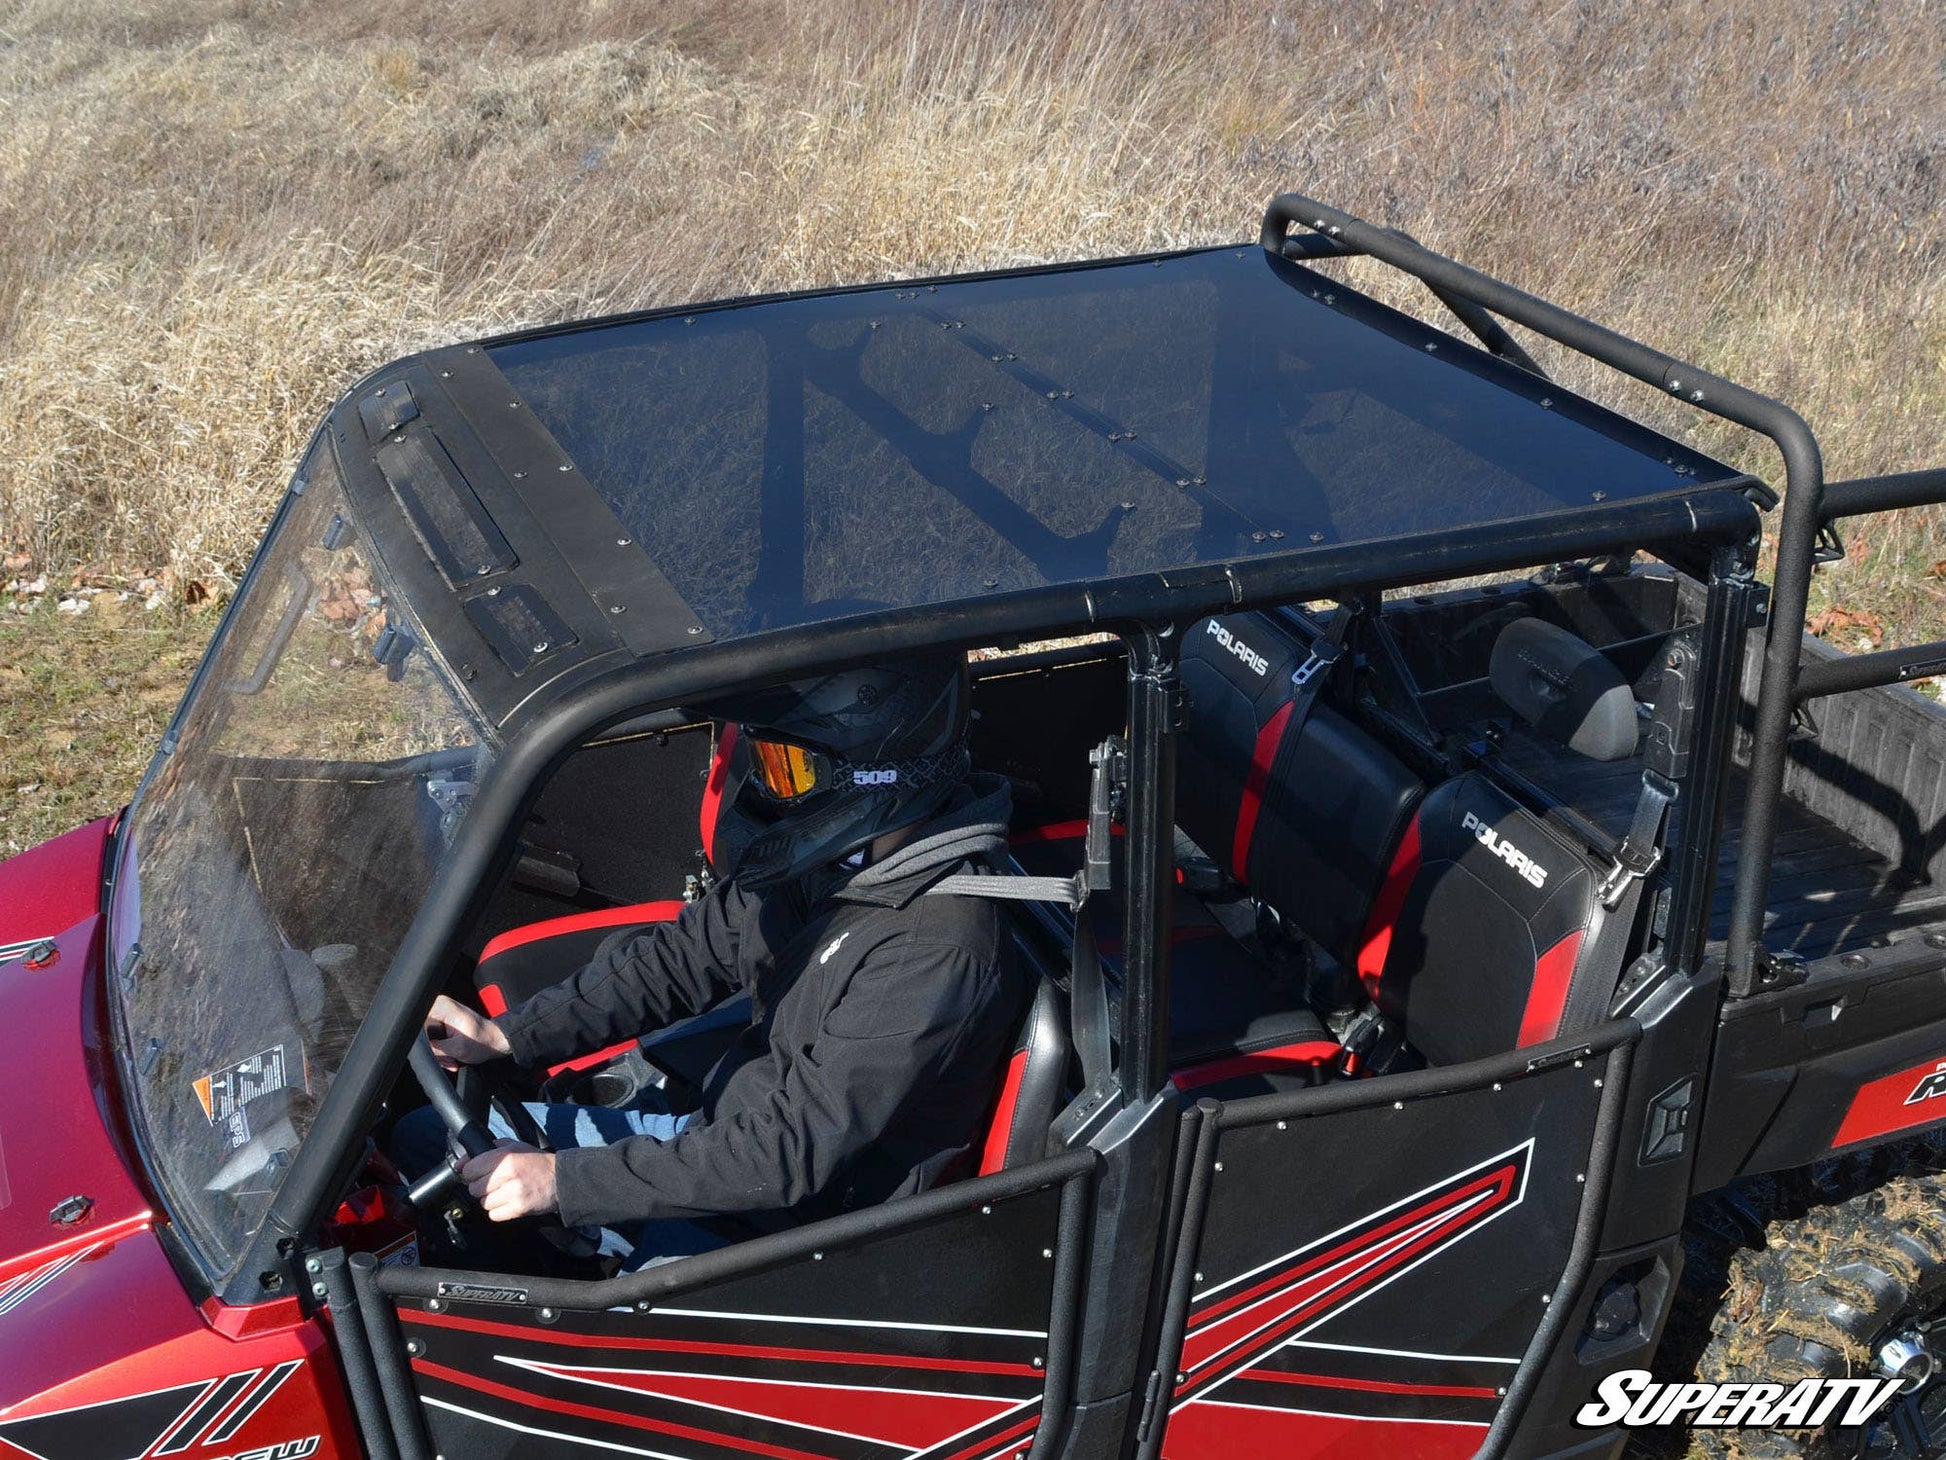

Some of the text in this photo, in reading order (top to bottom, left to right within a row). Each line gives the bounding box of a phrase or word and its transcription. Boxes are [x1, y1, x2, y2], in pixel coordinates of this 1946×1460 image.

[1206, 619, 1269, 676] POLARIS
[853, 769, 897, 785] 509
[1462, 811, 1548, 888] POLARIS
